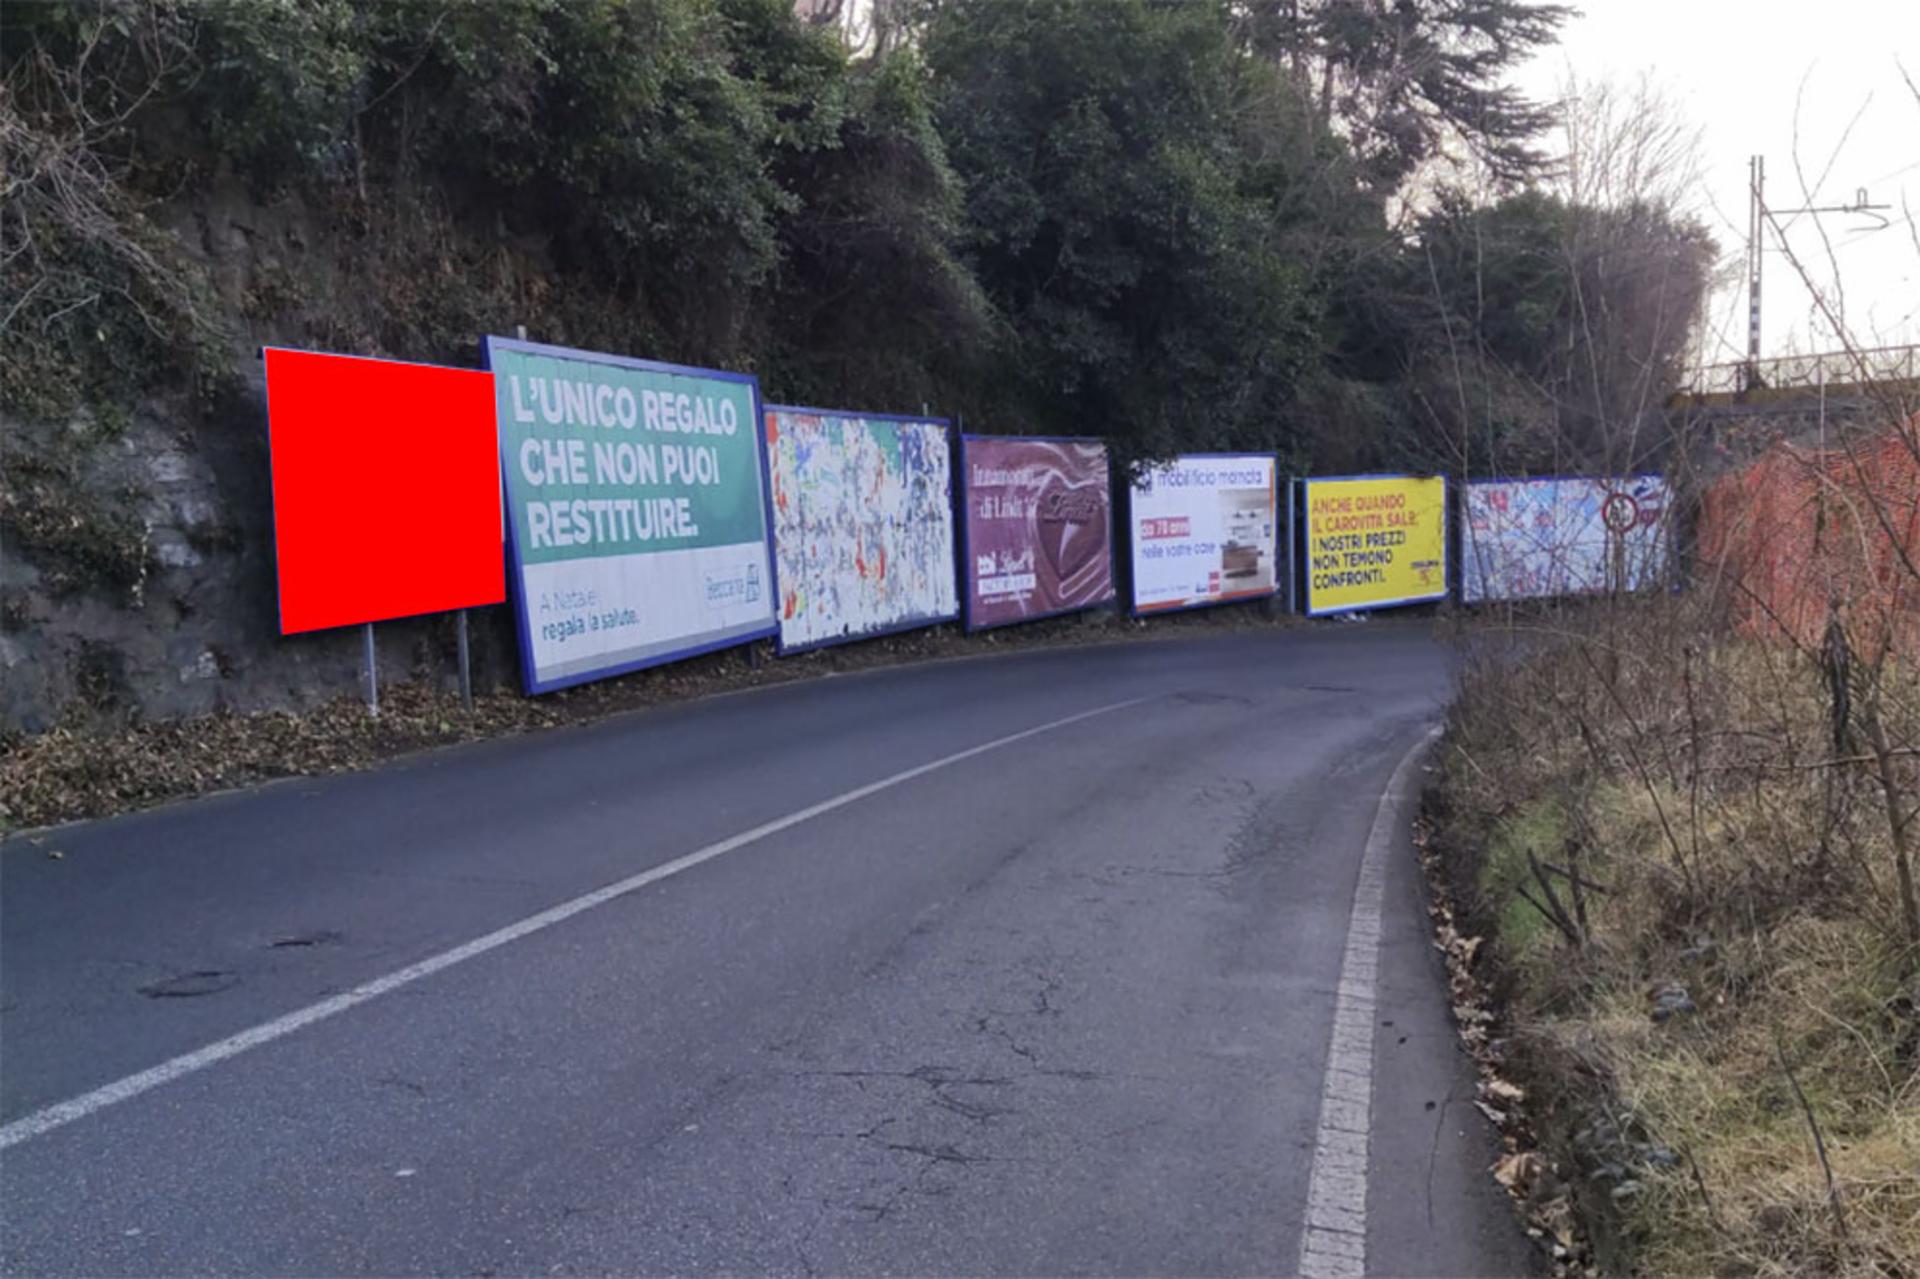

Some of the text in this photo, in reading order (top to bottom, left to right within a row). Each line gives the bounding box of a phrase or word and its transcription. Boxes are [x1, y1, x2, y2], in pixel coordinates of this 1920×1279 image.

[510, 375, 737, 436] L'UNICO REGALO
[520, 439, 719, 486] CHE NON PUOI
[1158, 469, 1215, 487] mobilificio
[1312, 494, 1405, 513] ANCHE QUANDO
[528, 498, 699, 549] RESTITUIRE.
[1313, 520, 1322, 533] IL
[1326, 515, 1382, 532] CAROVITA
[1312, 531, 1405, 552] I NOSTRI PREZZI
[1313, 556, 1339, 570] NON
[1344, 550, 1393, 567] TEMONO
[1313, 569, 1386, 589] CONFRONTI.
[540, 594, 553, 613] A
[542, 610, 640, 641] regala la salute.
